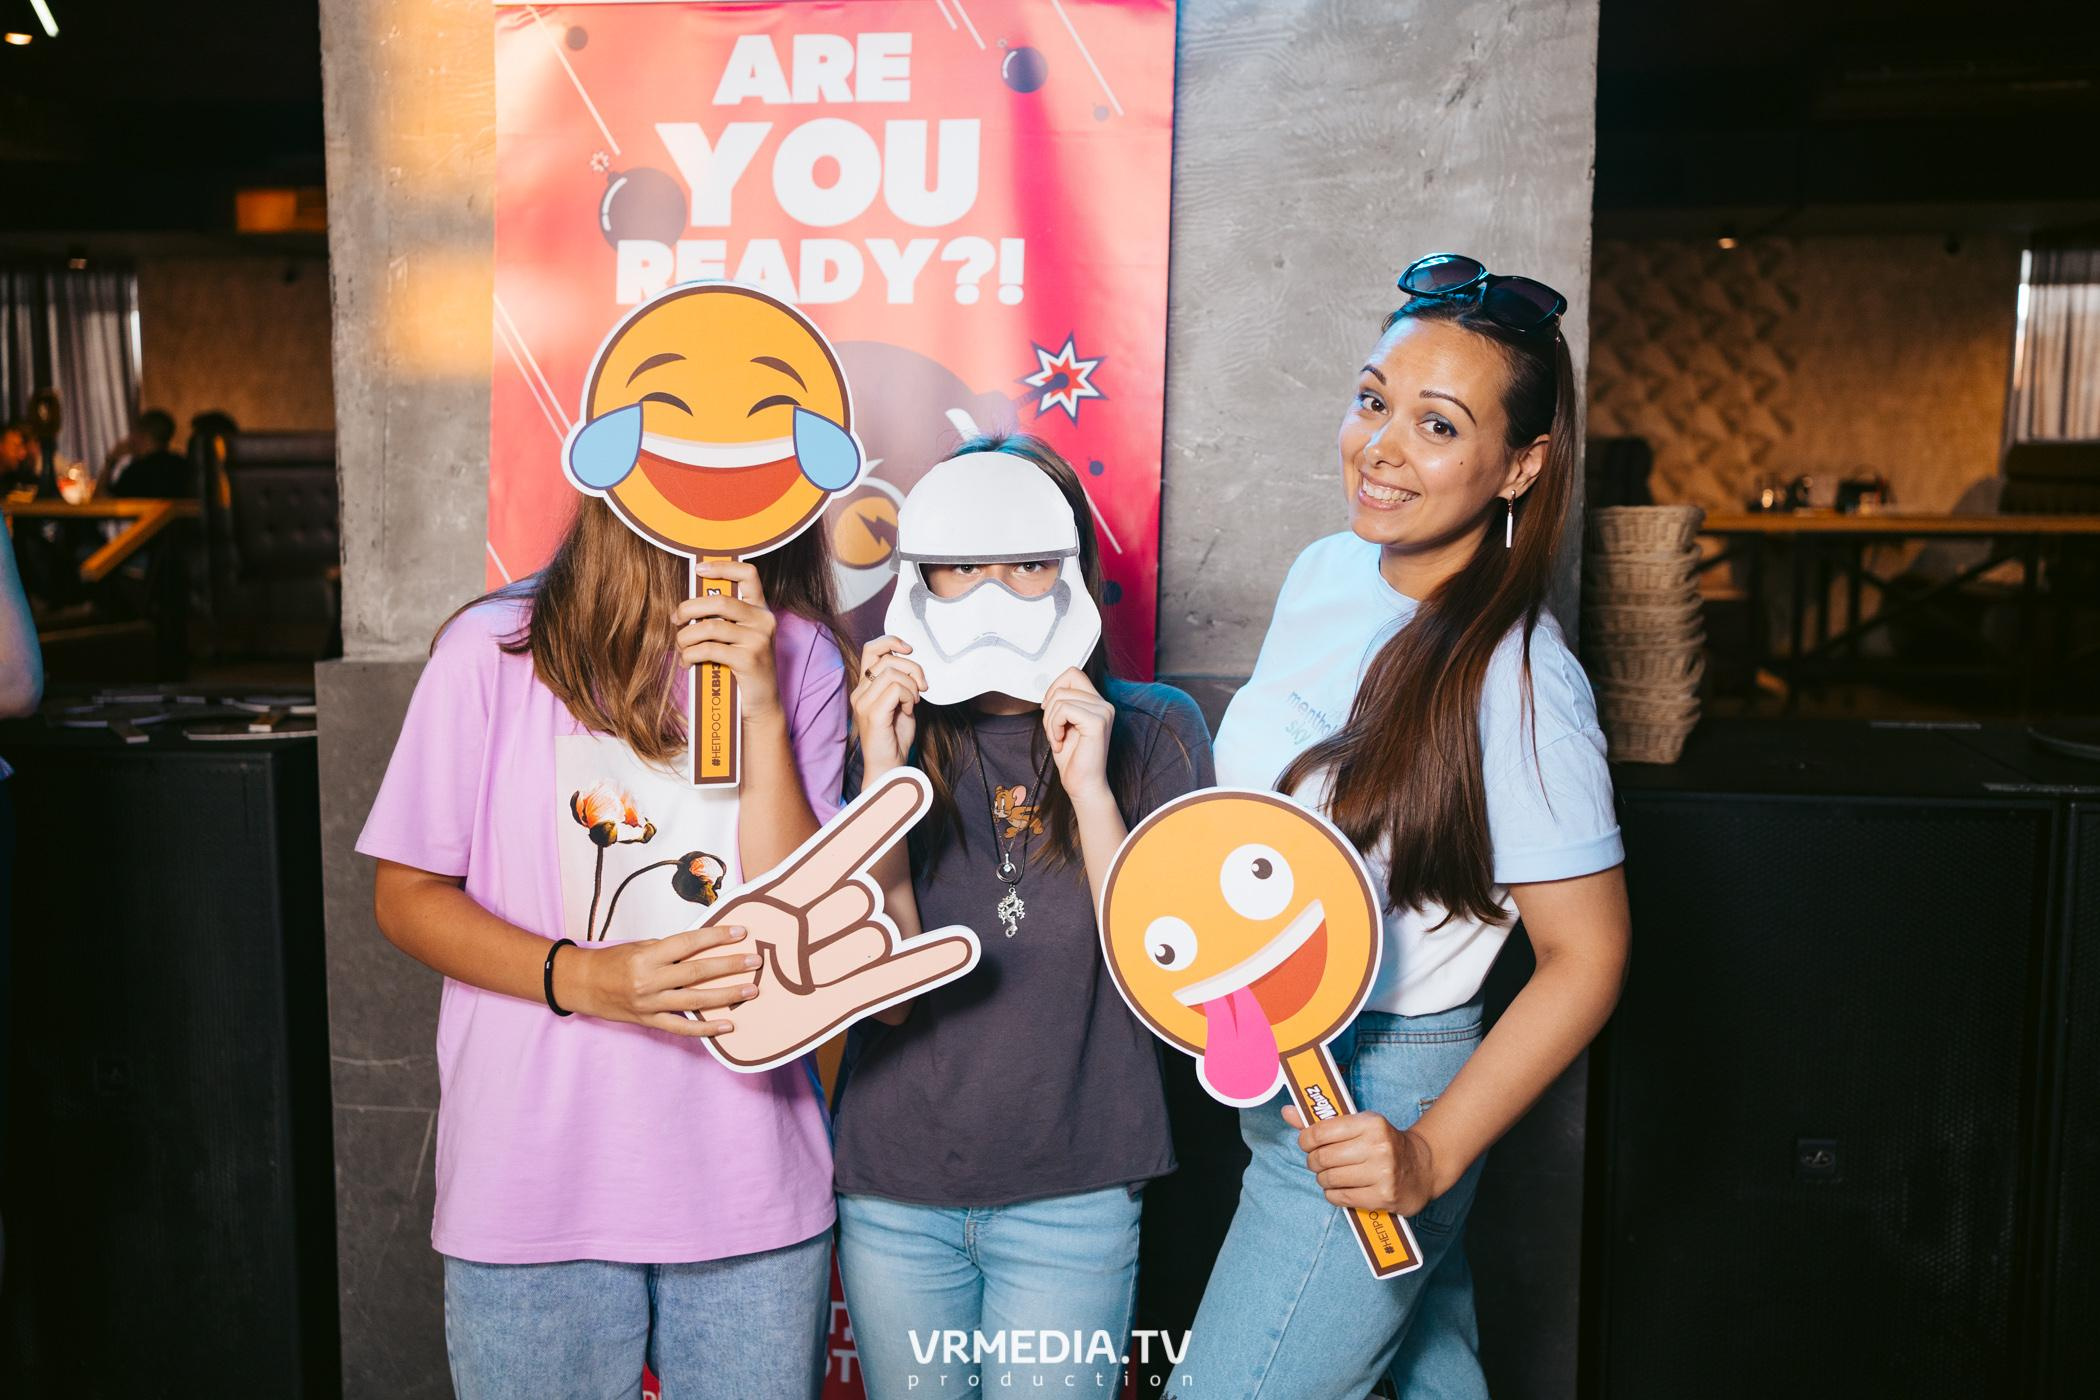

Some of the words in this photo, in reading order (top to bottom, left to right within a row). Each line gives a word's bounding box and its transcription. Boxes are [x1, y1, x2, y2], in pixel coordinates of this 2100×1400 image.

[713, 33, 911, 104] ARE
[656, 118, 980, 227] YOU
[617, 237, 1024, 304] READY?!
